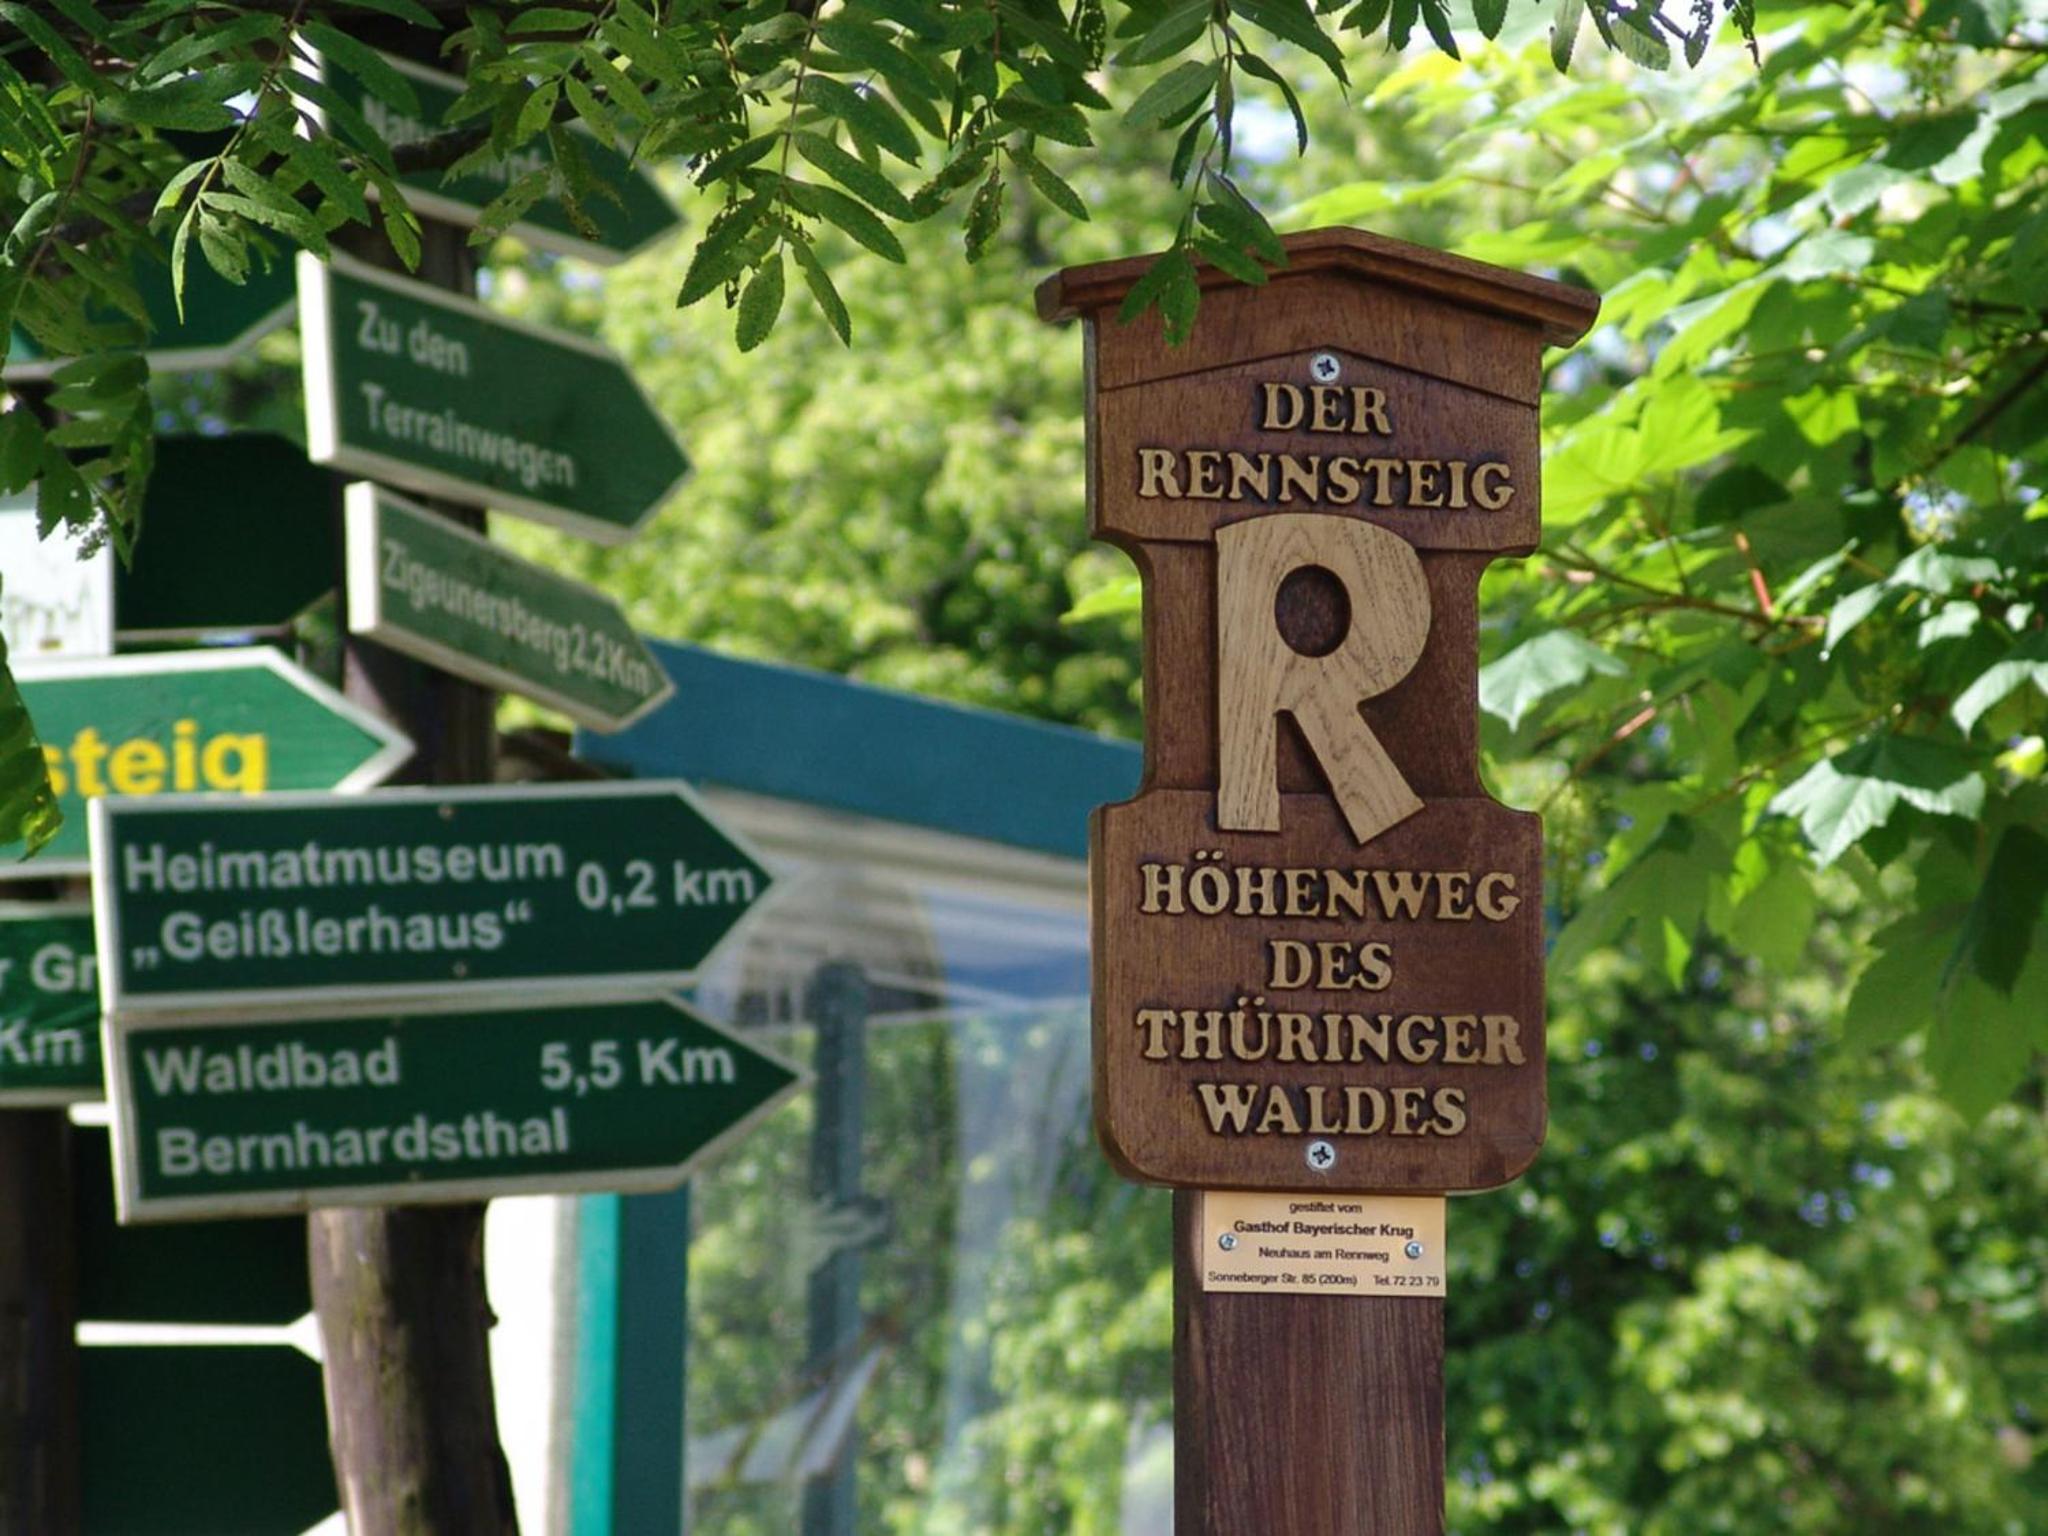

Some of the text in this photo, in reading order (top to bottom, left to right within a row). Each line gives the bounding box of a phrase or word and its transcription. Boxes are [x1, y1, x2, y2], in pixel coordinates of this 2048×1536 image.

[357, 300, 469, 376] Zu den
[361, 380, 577, 489] Terrainwegen
[1262, 382, 1392, 435] DER
[1138, 448, 1515, 512] RENNSTEIG
[1215, 512, 1432, 845] R
[123, 842, 564, 891] Heimatmuseum
[575, 859, 756, 916] 0,2 km
[1140, 850, 1521, 922] HÖHENWEG
[1269, 939, 1393, 991] DES
[1136, 996, 1526, 1066] THÜRINGER
[144, 1036, 736, 1096] Waldbad 5,5 Km
[1198, 1083, 1467, 1136] WALDES
[157, 1106, 569, 1176] Bernhardsthal
[1233, 1220, 1414, 1239] Gasthof Bayerischer Krug
[1289, 1202, 1362, 1214] gestiftet vom
[1208, 1271, 1278, 1285] Sonneberger
[1302, 1274, 1317, 1284] 85
[1318, 1274, 1358, 1287] (200m)
[1393, 1276, 1406, 1286] 72
[1409, 1276, 1423, 1286] 23
[1259, 1247, 1390, 1263] Neuhaus am Rennweg
